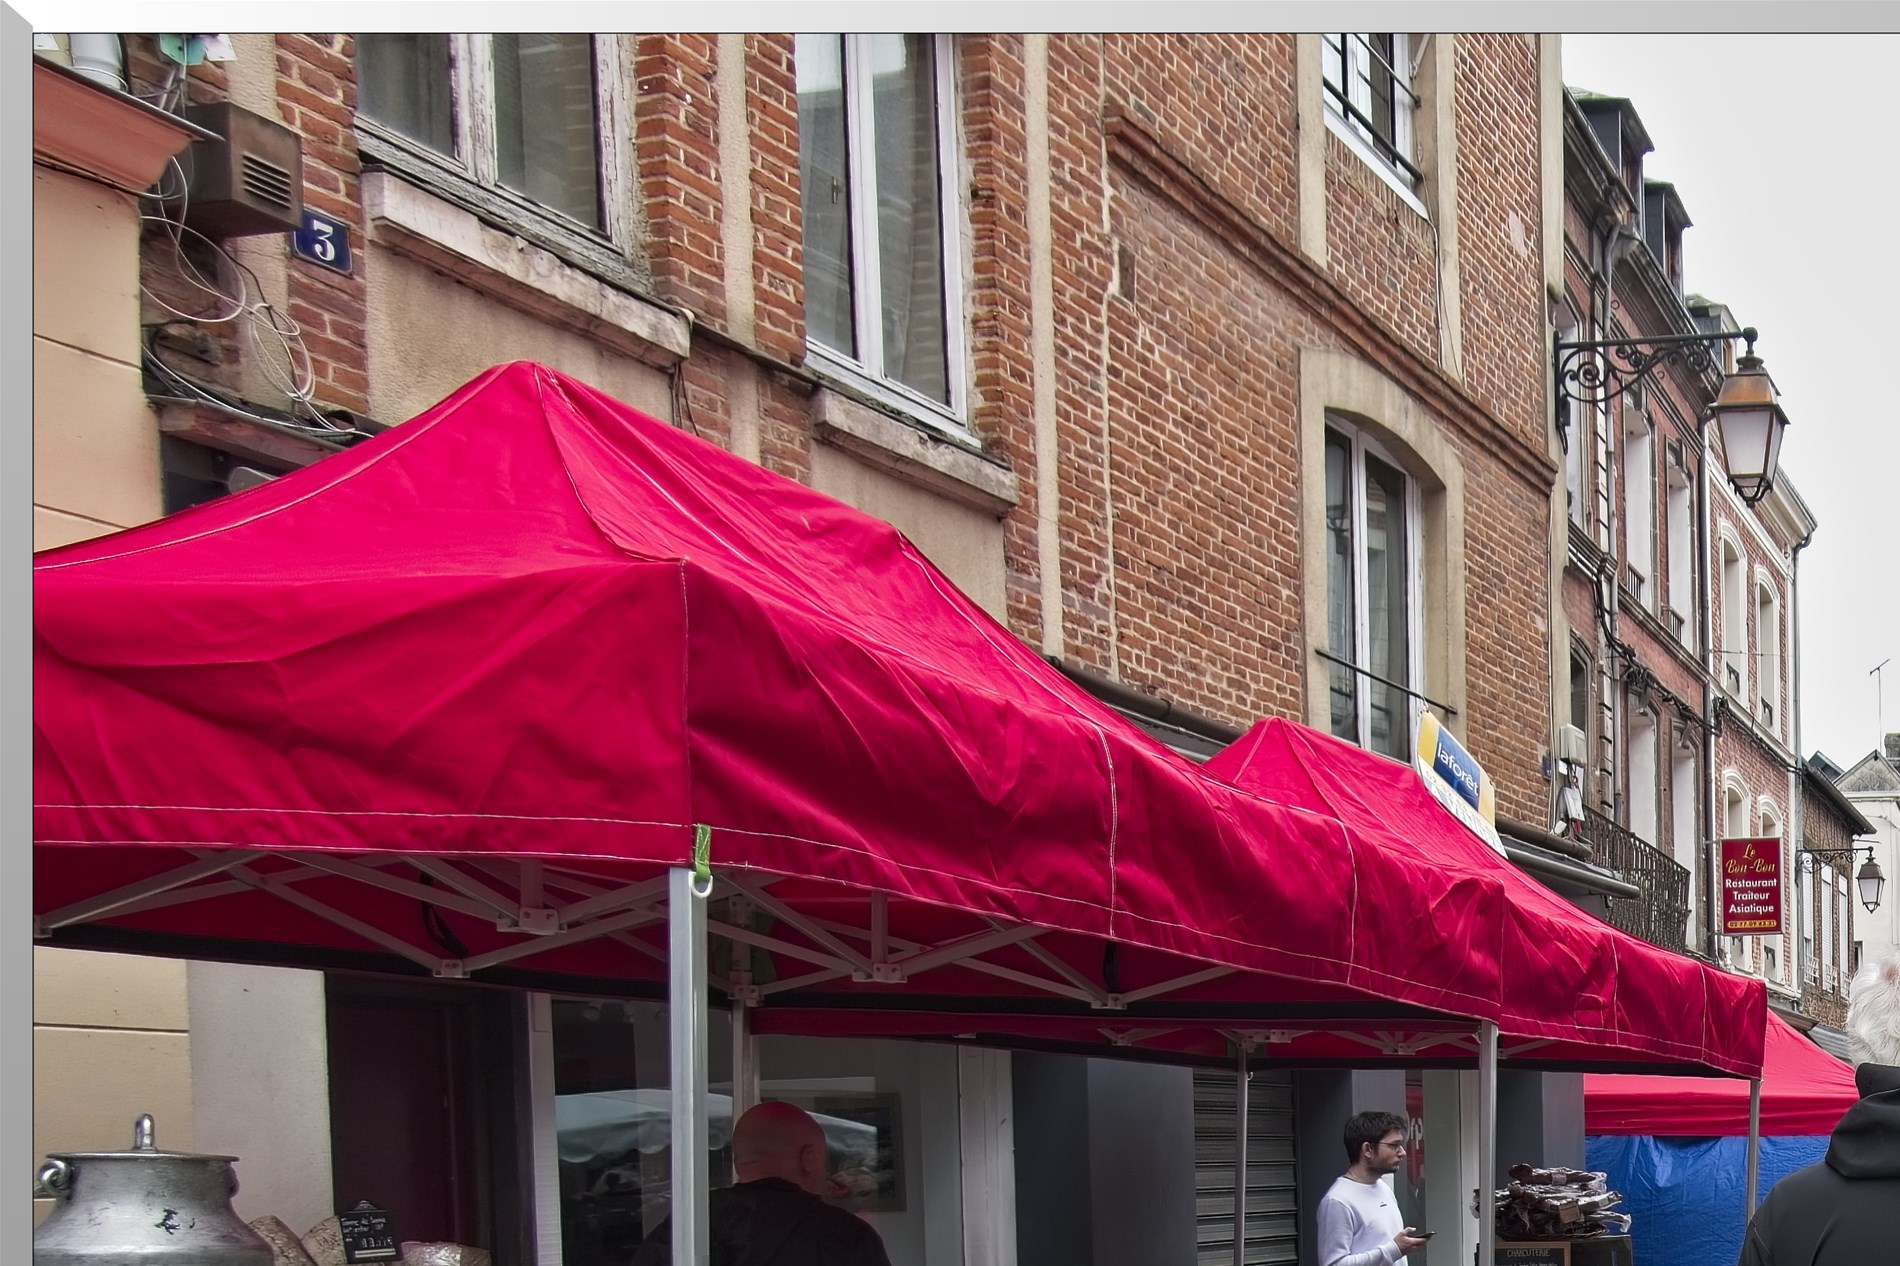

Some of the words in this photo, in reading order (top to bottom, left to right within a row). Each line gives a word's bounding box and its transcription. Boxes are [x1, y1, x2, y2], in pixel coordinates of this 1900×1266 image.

[313, 219, 335, 261] 3
[1437, 742, 1480, 797] laforêt
[1743, 843, 1756, 860] Le
[1725, 878, 1777, 888] Restaurant
[1733, 890, 1770, 901] Traiteur
[1729, 903, 1775, 916] Asiatique
